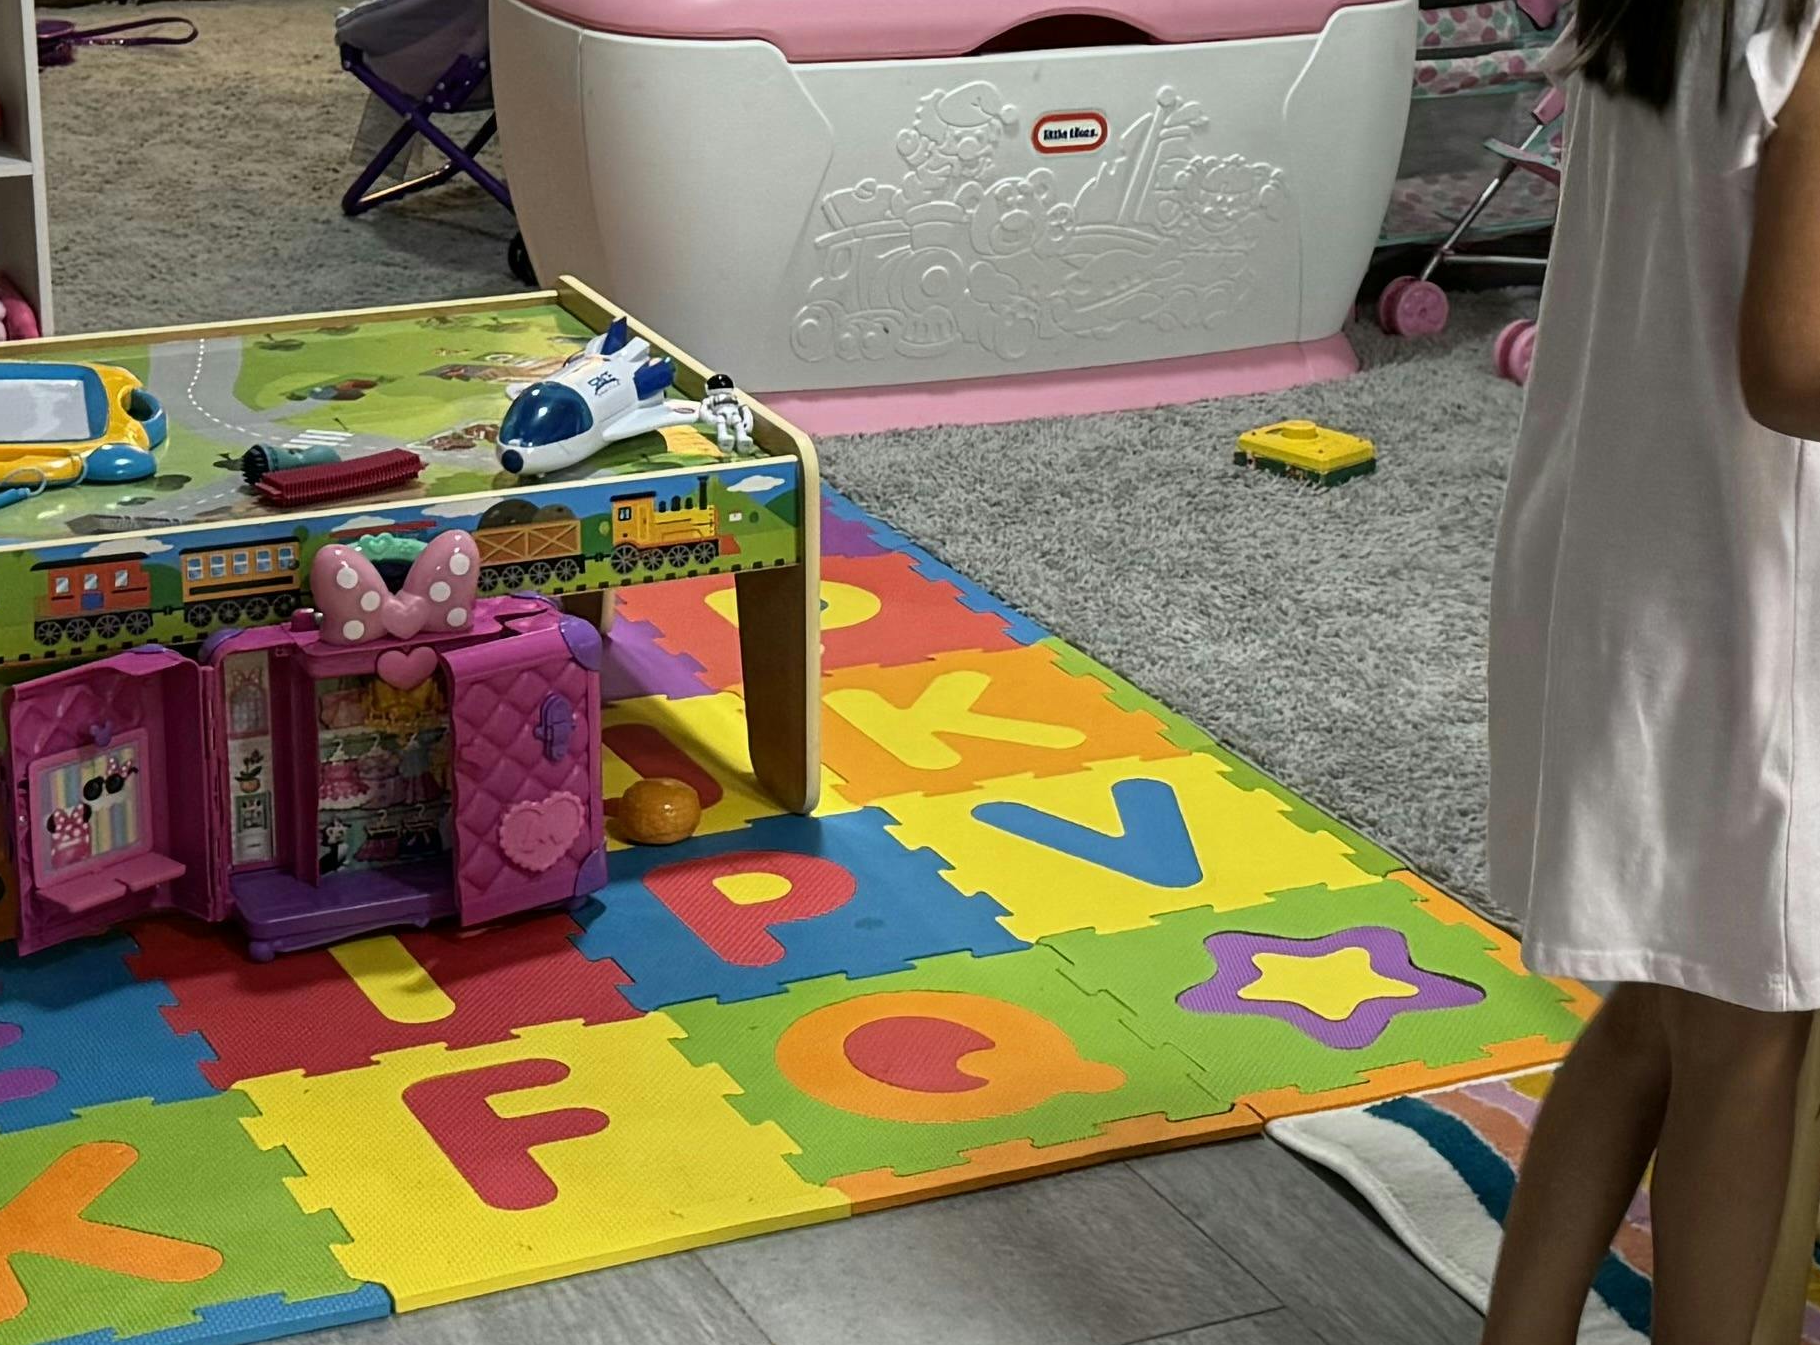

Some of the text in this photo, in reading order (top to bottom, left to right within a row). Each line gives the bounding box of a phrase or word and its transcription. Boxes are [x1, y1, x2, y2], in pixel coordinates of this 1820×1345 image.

[822, 670, 1087, 770] K
[971, 778, 1204, 888] V
[644, 850, 857, 967] P
[402, 1058, 610, 1211] F
